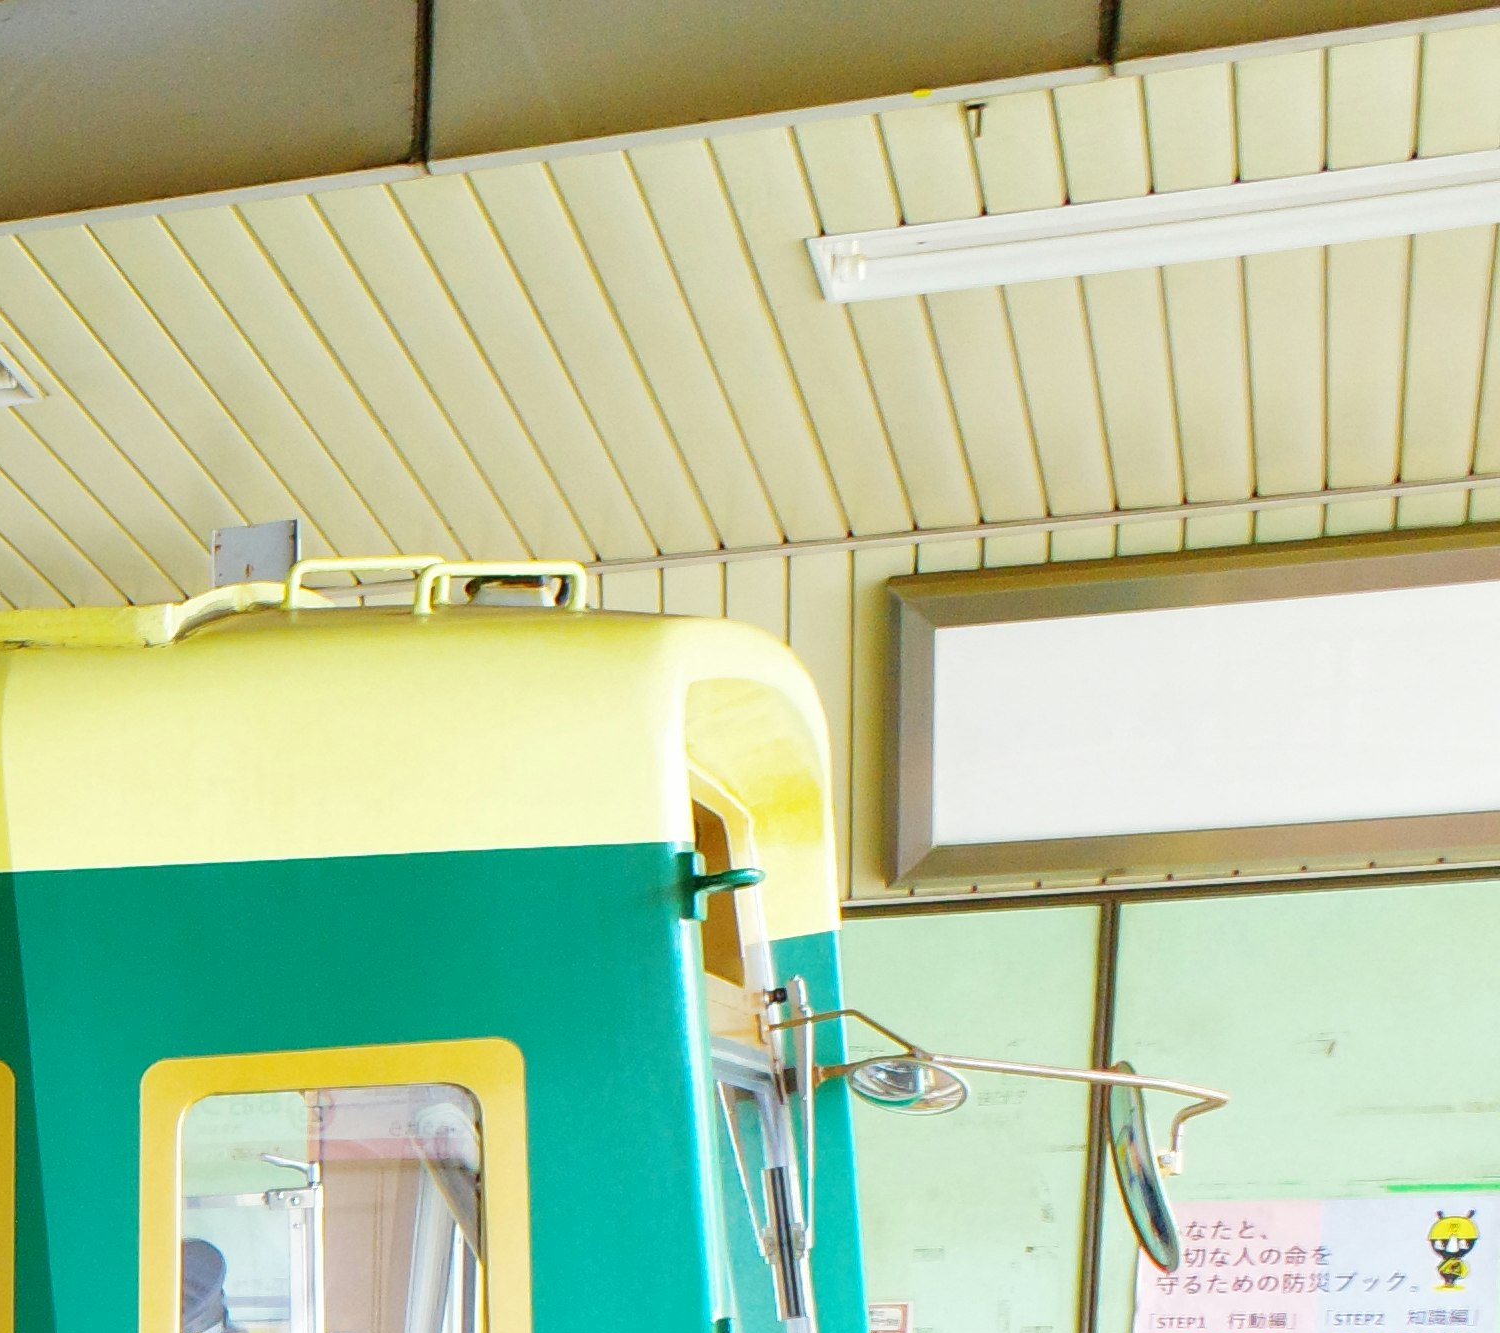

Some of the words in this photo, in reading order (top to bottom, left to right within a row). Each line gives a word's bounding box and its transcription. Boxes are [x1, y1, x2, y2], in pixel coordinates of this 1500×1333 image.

[1181, 1220, 1269, 1241] なたと、
[1181, 1246, 1332, 1268] 切な人の命を
[1156, 1271, 1419, 1296] 守るための防災ブック。
